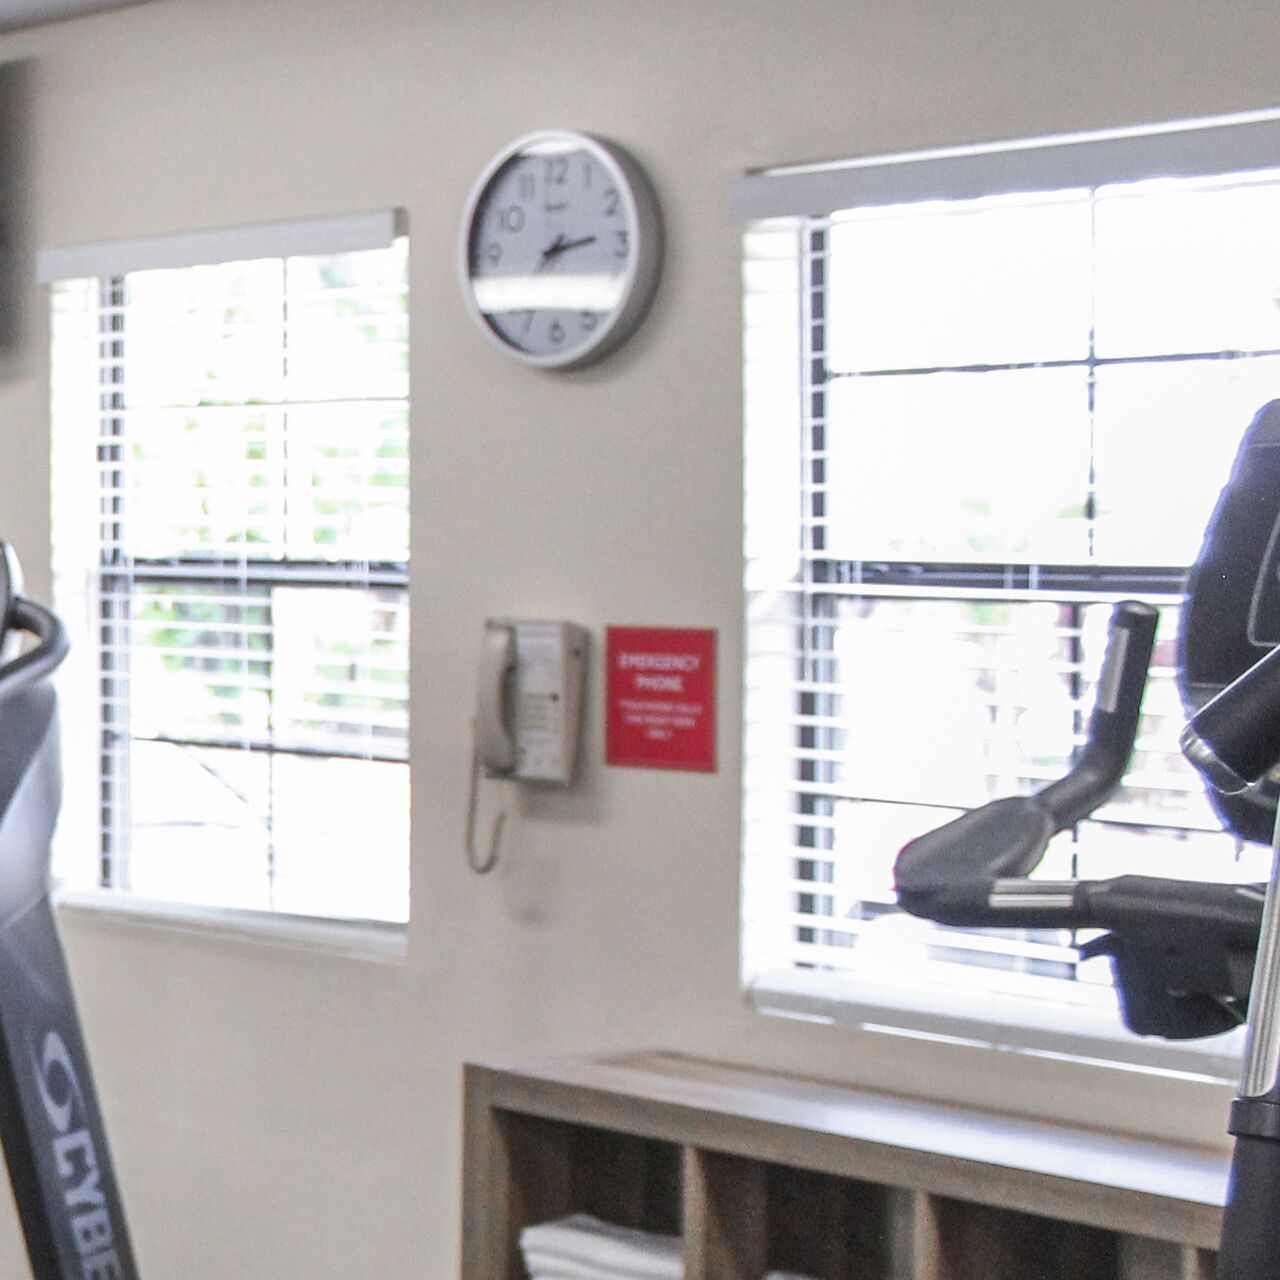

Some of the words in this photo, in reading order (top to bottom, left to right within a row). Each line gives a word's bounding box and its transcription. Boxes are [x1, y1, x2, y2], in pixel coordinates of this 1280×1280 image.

[544, 157, 569, 185] 12
[604, 187, 620, 217] 2
[500, 205, 526, 233] 10
